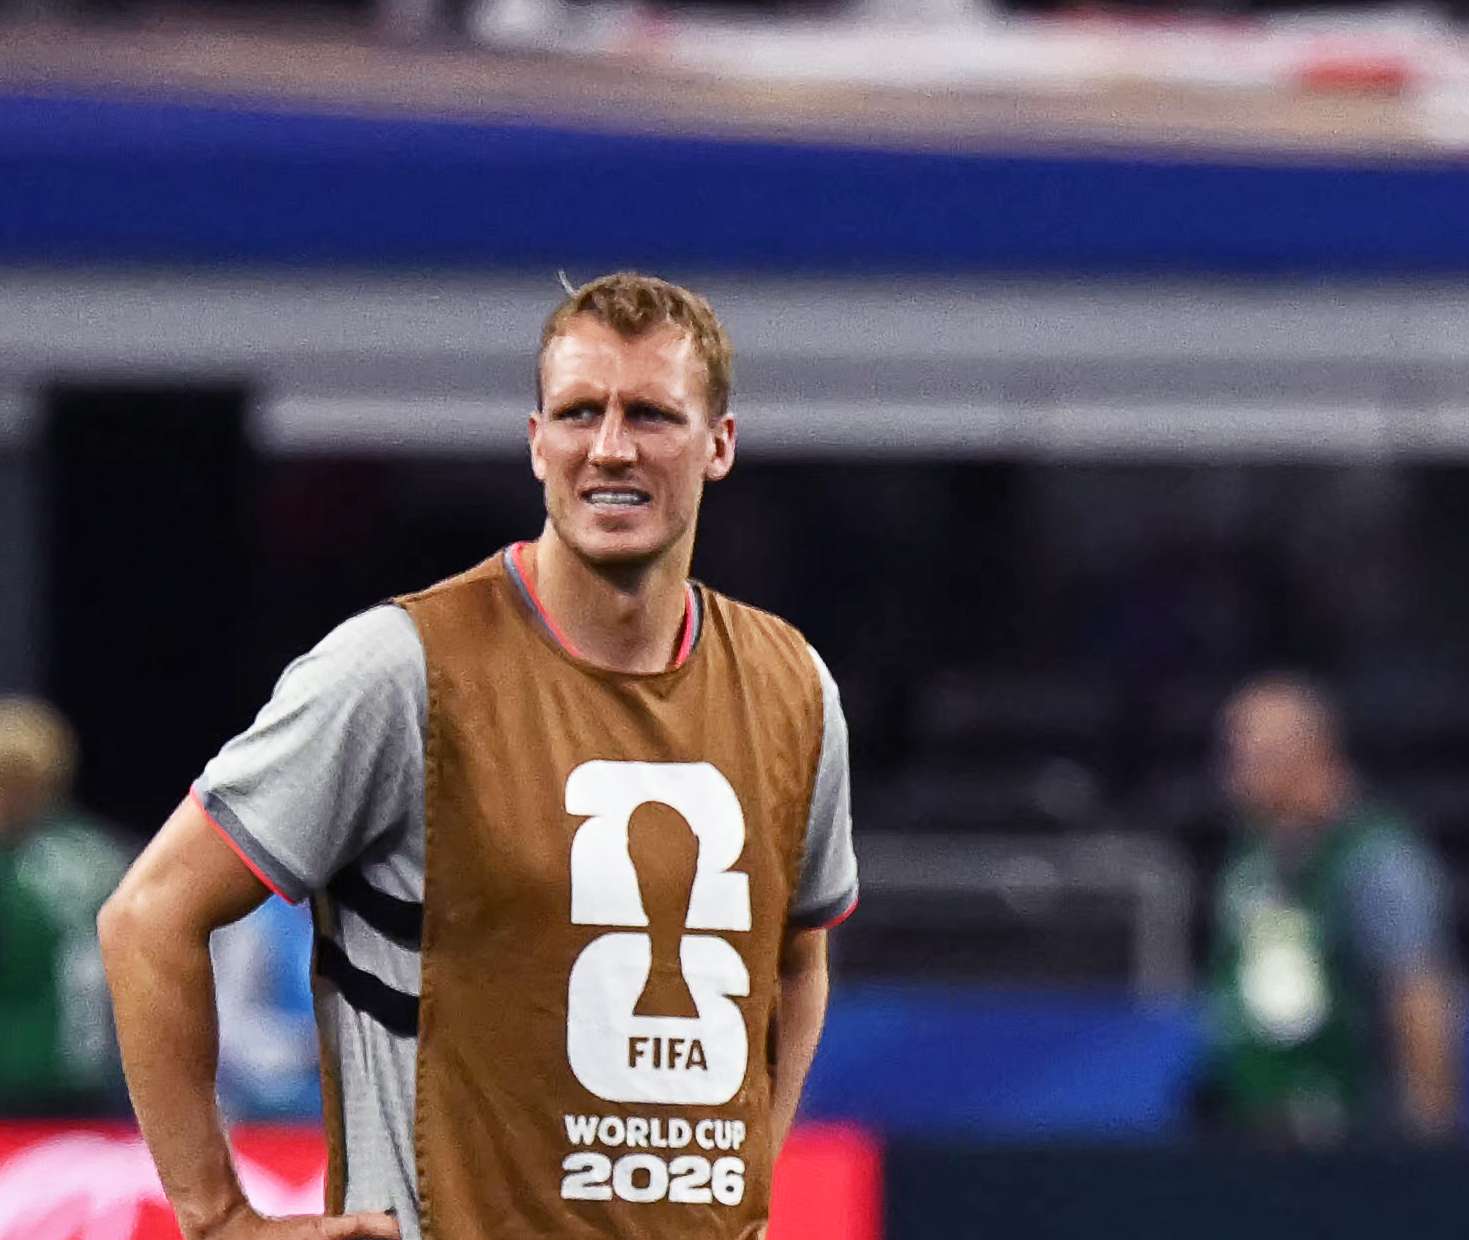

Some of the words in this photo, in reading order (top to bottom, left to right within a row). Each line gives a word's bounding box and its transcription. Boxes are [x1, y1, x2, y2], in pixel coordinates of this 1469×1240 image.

[628, 1036, 708, 1071] FIFA
[564, 1114, 691, 1150] WORLD
[695, 1118, 746, 1151] CUP
[561, 1152, 746, 1206] 2026
